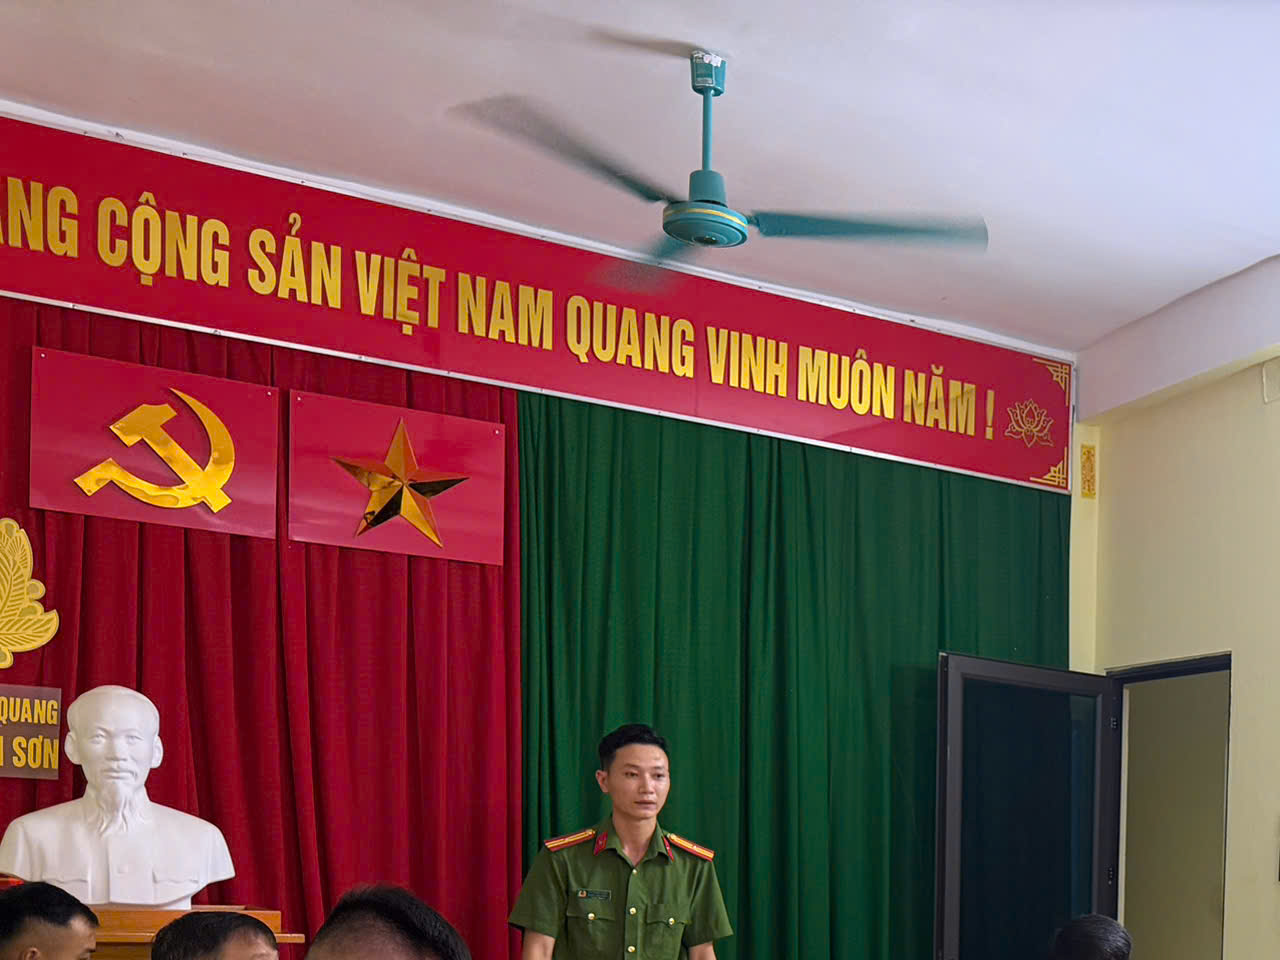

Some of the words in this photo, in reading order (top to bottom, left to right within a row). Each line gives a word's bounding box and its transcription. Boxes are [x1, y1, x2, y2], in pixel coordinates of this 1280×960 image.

[0, 176, 79, 258] NG
[98, 191, 230, 288] CỘNG
[247, 212, 342, 309] SẢN
[355, 248, 446, 335] VIỆT
[457, 272, 554, 351] NAM
[567, 295, 695, 379] QUANG
[707, 326, 788, 397] VINH
[798, 348, 896, 419] MUÔN
[903, 364, 977, 437] NĂM
[984, 390, 995, 440] !
[12, 735, 59, 769] SƠN
